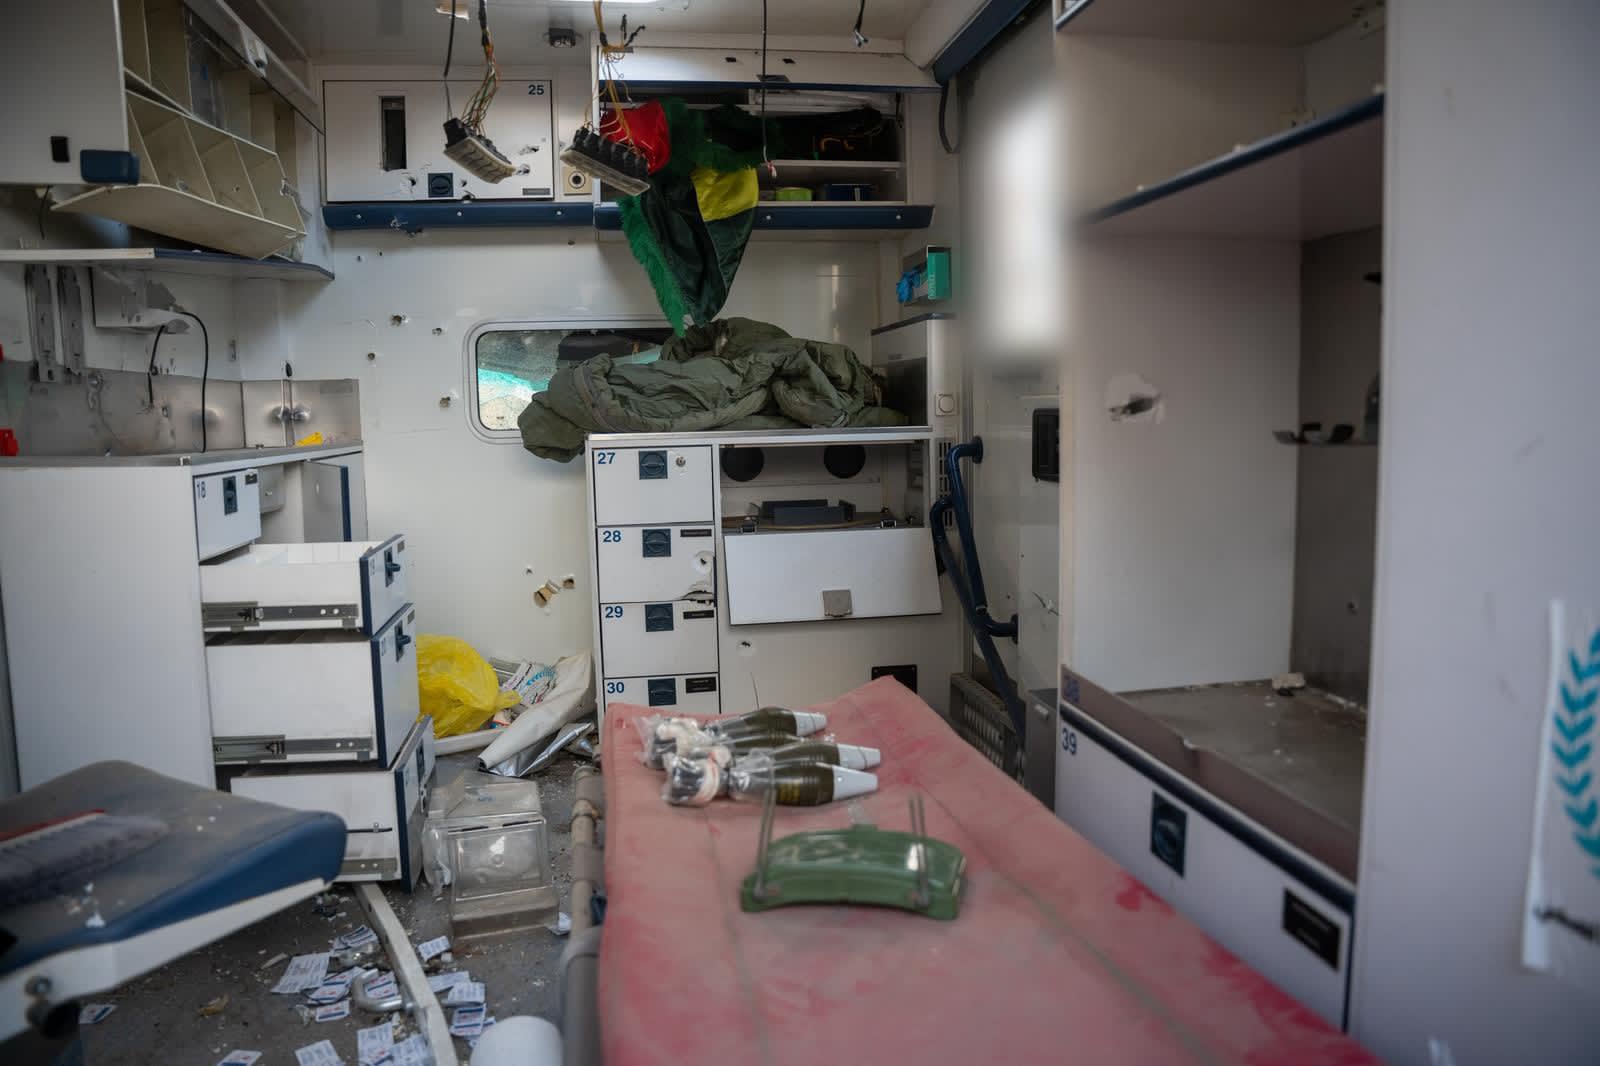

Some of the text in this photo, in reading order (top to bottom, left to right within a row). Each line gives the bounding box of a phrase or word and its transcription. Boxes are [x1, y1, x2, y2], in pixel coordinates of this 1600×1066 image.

[528, 84, 545, 95] 25
[597, 452, 616, 464] 27
[602, 530, 622, 543] 28
[604, 606, 624, 618] 29
[606, 682, 625, 694] 30
[1062, 727, 1078, 756] 39
